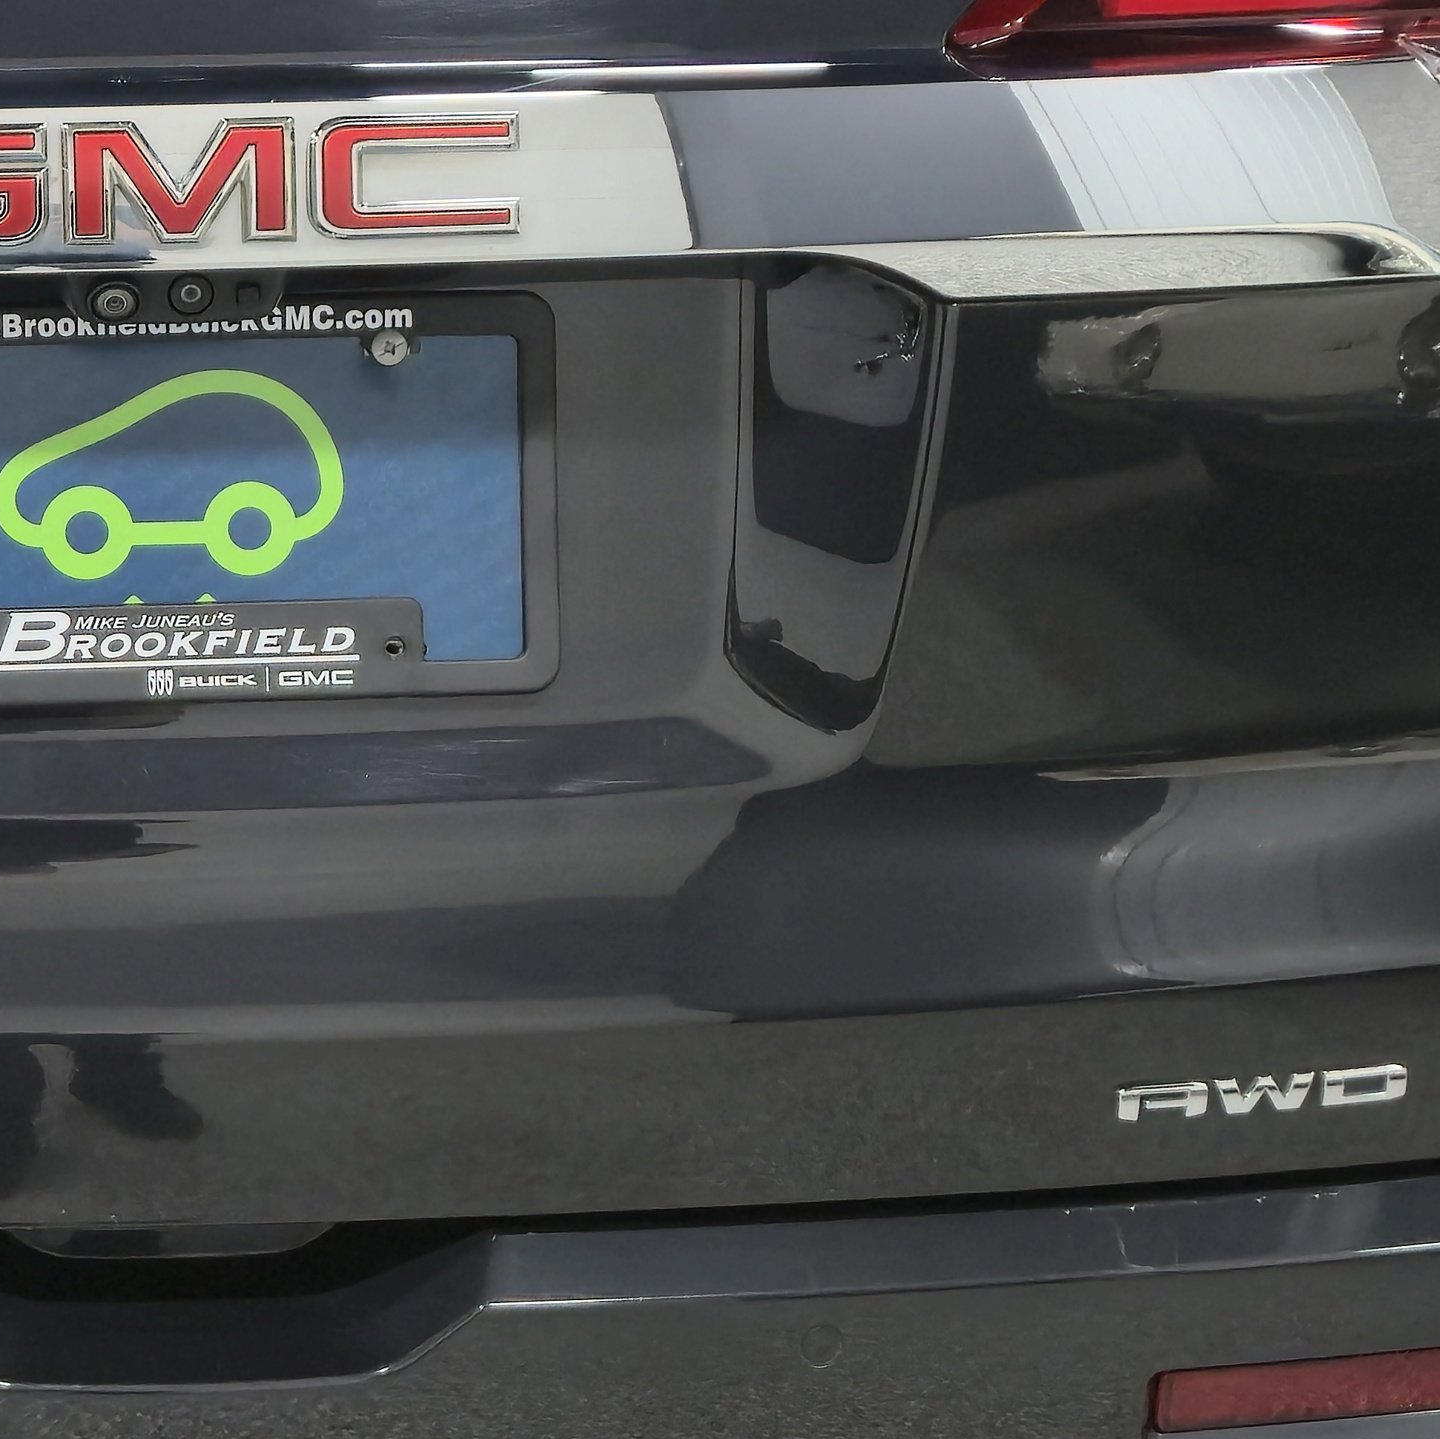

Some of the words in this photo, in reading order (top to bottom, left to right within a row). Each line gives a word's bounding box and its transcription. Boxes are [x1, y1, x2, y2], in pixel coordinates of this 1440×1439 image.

[73, 615, 128, 631] MIKE
[132, 612, 235, 630] JUNEAU'S
[179, 672, 257, 689] BUICK
[278, 669, 354, 687] GMC
[1116, 1062, 1409, 1122] AWD
